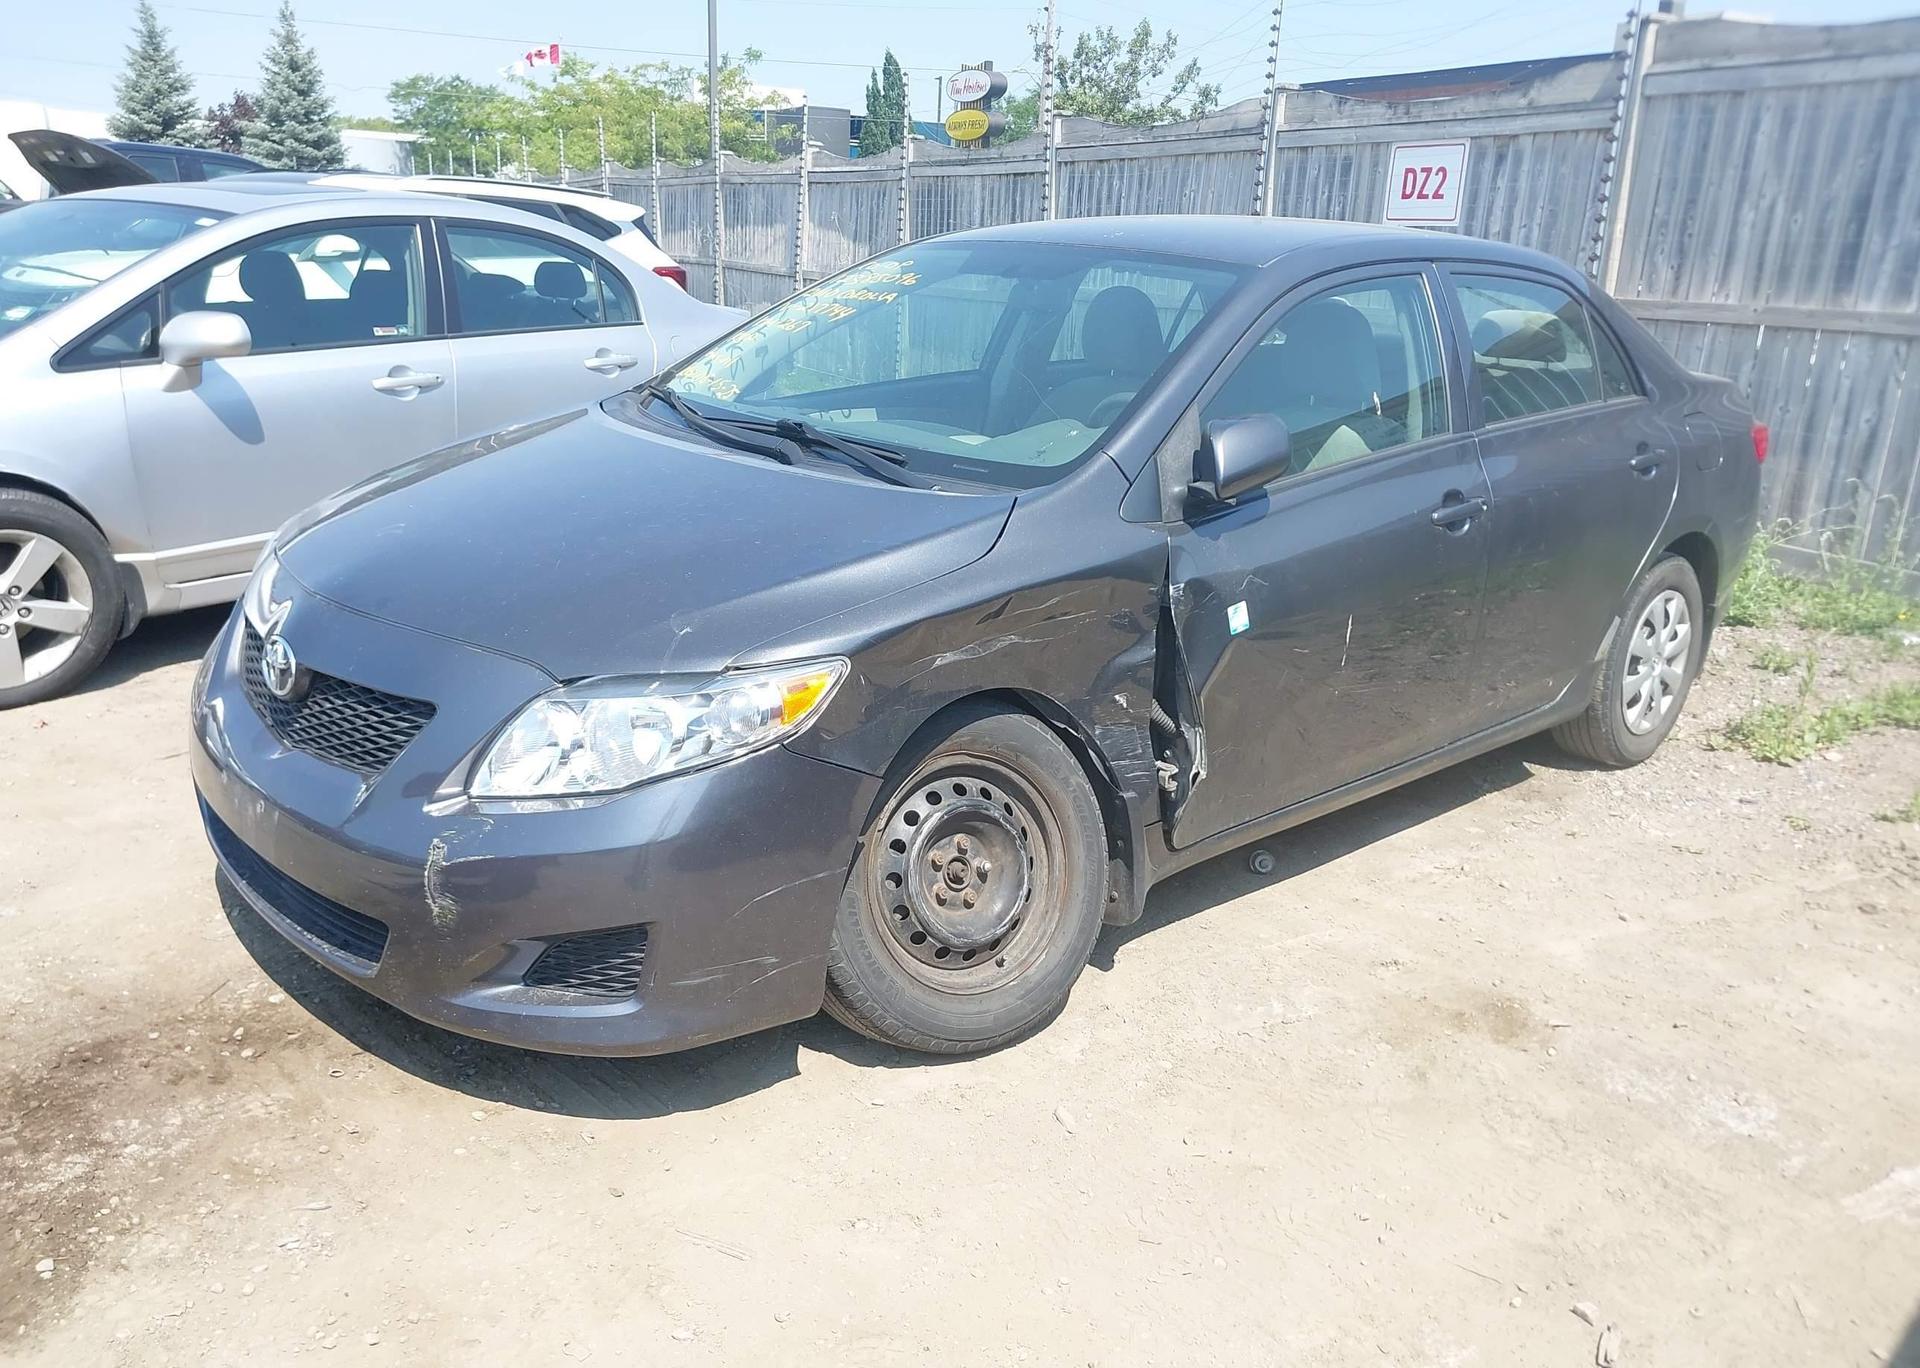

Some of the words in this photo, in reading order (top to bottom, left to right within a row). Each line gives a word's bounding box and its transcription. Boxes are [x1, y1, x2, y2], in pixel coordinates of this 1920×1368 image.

[950, 79, 962, 96] Tim
[968, 119, 986, 130] FRESH
[1401, 166, 1448, 199] DZ2
